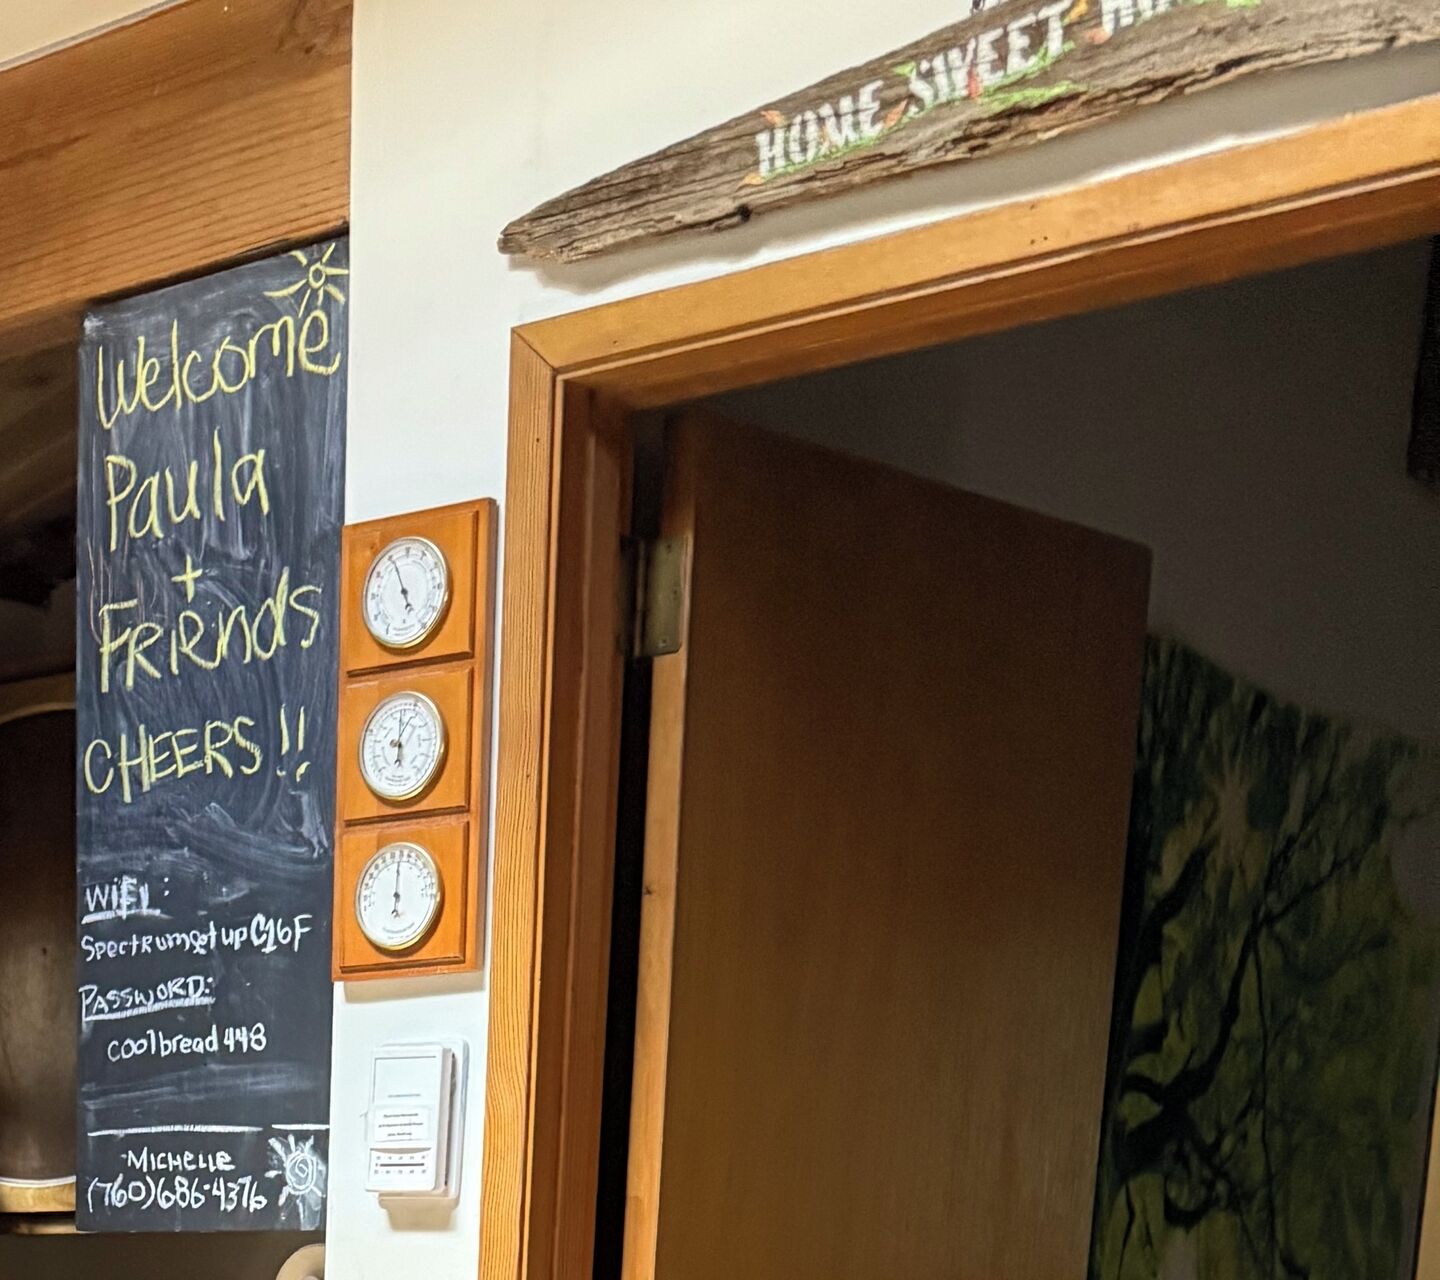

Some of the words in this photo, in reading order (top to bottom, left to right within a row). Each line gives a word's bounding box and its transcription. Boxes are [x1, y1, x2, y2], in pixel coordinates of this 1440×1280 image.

[755, 79, 885, 177] HOME
[908, 0, 1070, 117] SWEET
[97, 311, 341, 430] Welcome
[105, 426, 270, 553] Paula
